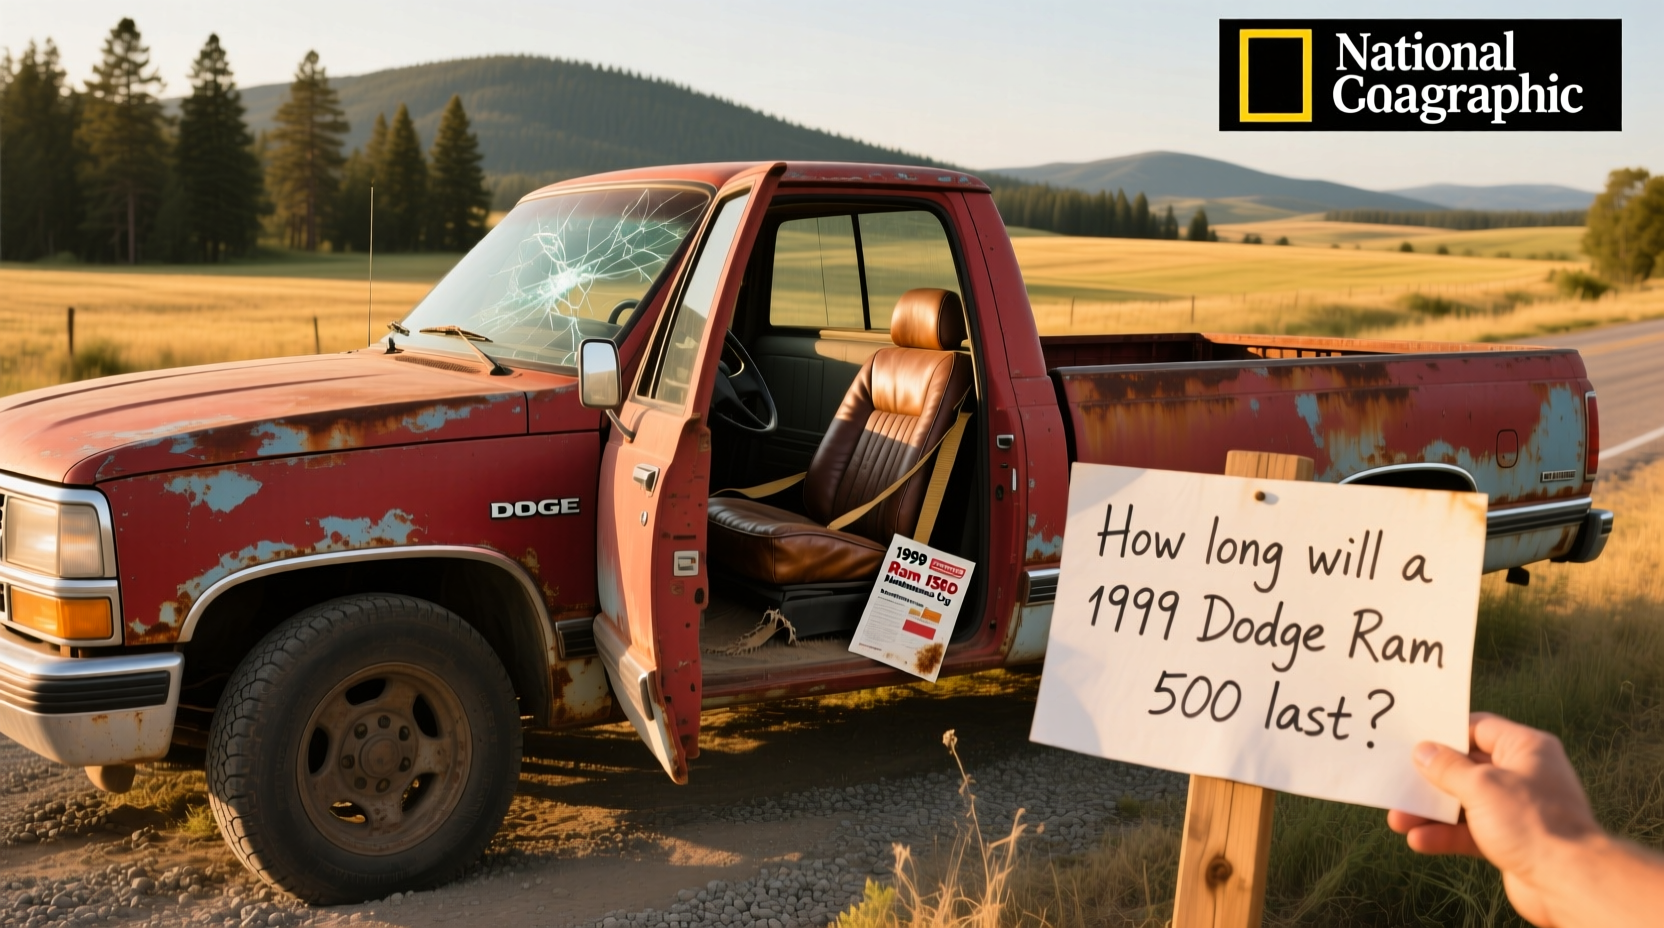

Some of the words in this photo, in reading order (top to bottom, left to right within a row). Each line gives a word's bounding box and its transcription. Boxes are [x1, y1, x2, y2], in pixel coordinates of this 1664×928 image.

[491, 498, 579, 518] DOGE
[888, 560, 921, 584] Ram
[1098, 504, 1185, 560] How
[1206, 516, 1283, 593] long
[1309, 530, 1383, 580] will
[1402, 555, 1432, 584] a
[1089, 585, 1179, 640] 1999
[1197, 595, 1325, 672] Dodge
[1349, 609, 1443, 668] Ram
[1148, 671, 1241, 722] 500
